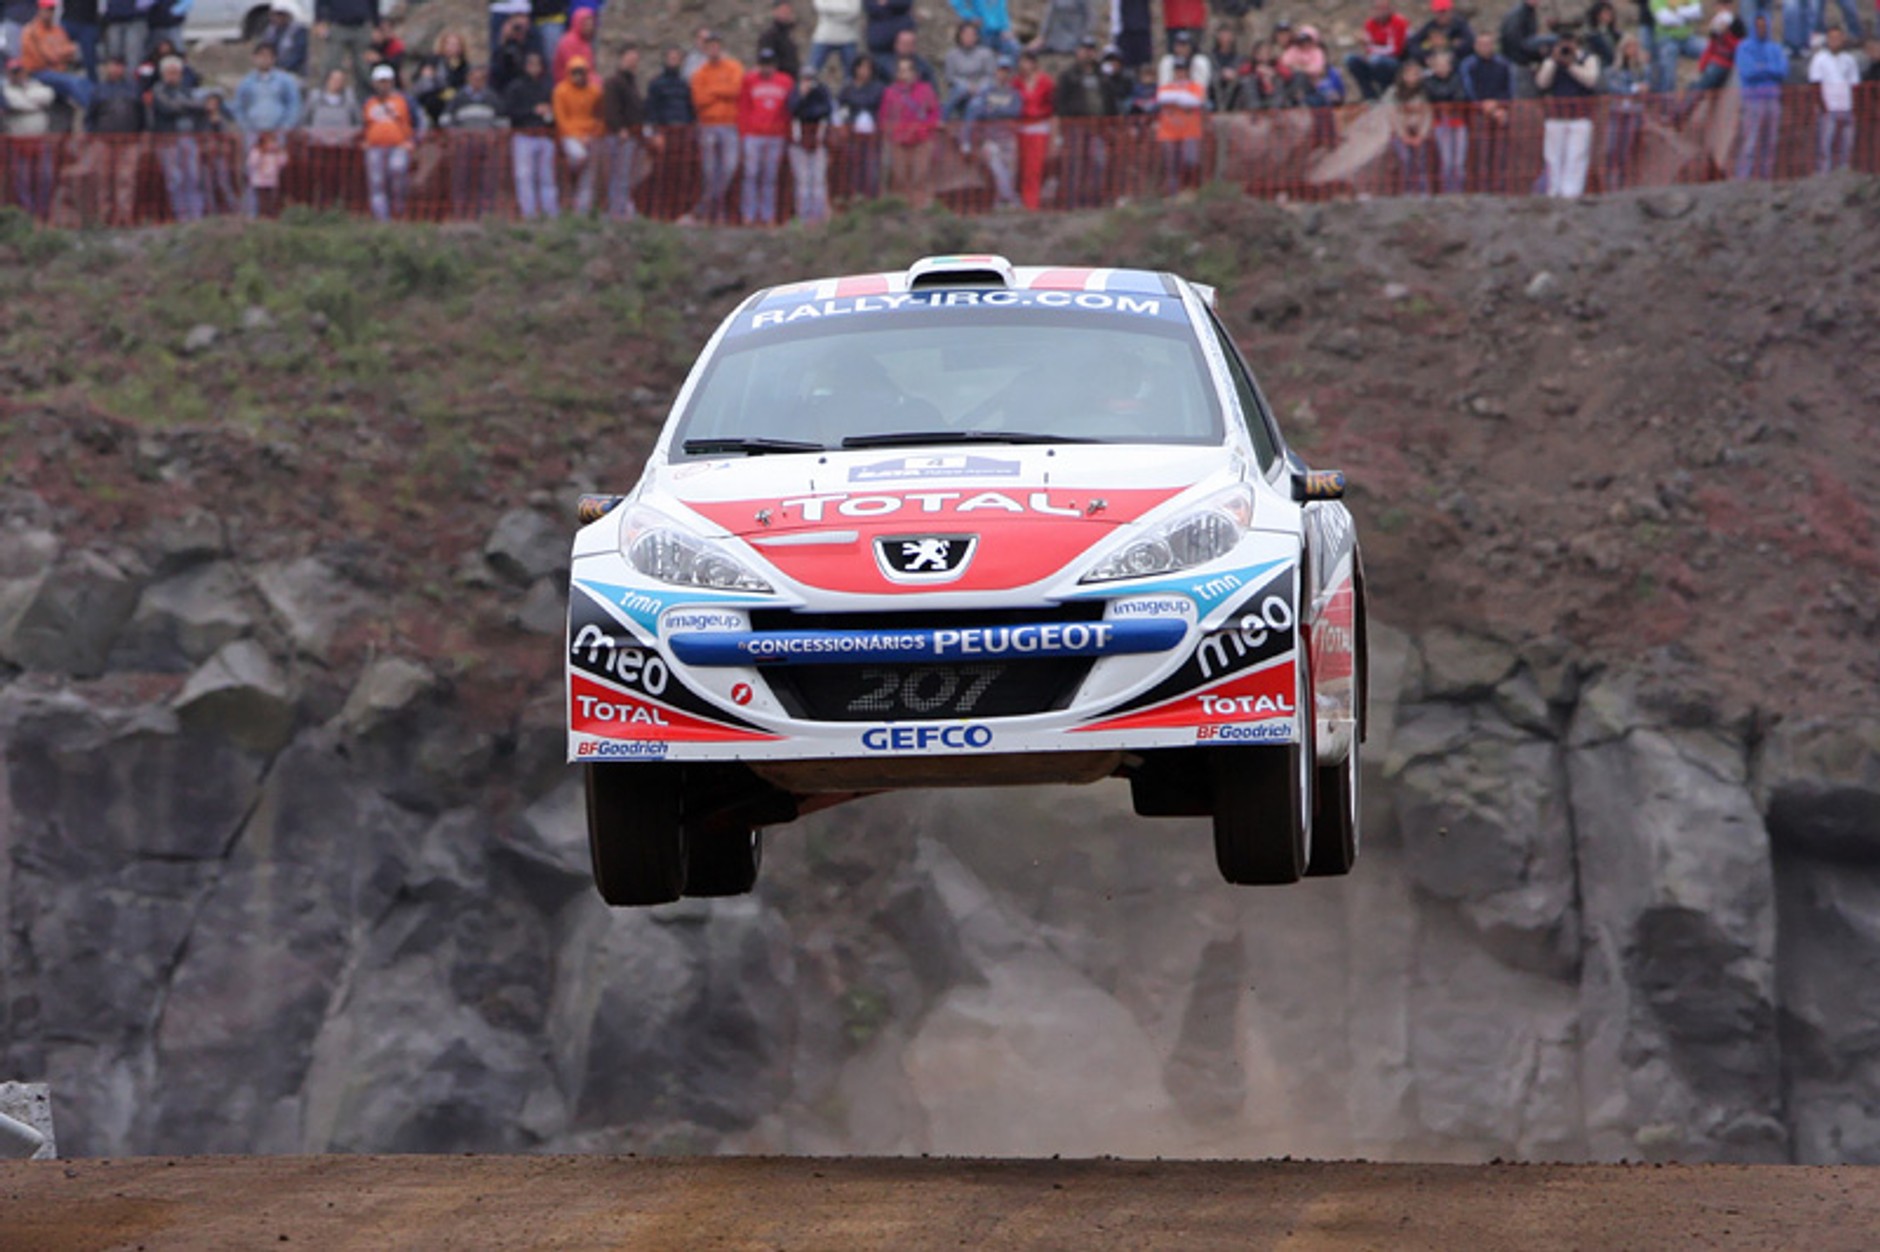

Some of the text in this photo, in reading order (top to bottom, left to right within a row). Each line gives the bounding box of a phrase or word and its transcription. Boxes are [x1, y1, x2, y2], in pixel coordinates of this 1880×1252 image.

[752, 290, 1161, 329] RALLY-IRC.COM
[1306, 470, 1345, 496] IRC
[781, 492, 1082, 521] TOTAL
[1192, 574, 1242, 600] tmn
[620, 591, 662, 615] tmn
[1113, 600, 1190, 616] imageup
[665, 613, 741, 630] imageup
[749, 624, 1113, 655] CONCESSIONÁRIOS PEUGEOT
[1197, 595, 1293, 679] meo
[571, 624, 669, 696] meo
[847, 664, 1006, 713] 207
[576, 695, 670, 727] TOTAL
[1198, 693, 1295, 716] TOTAL
[861, 725, 993, 751] GEFCO
[1196, 723, 1292, 740] BFGoodrich
[577, 740, 669, 756] BFGoodrich
